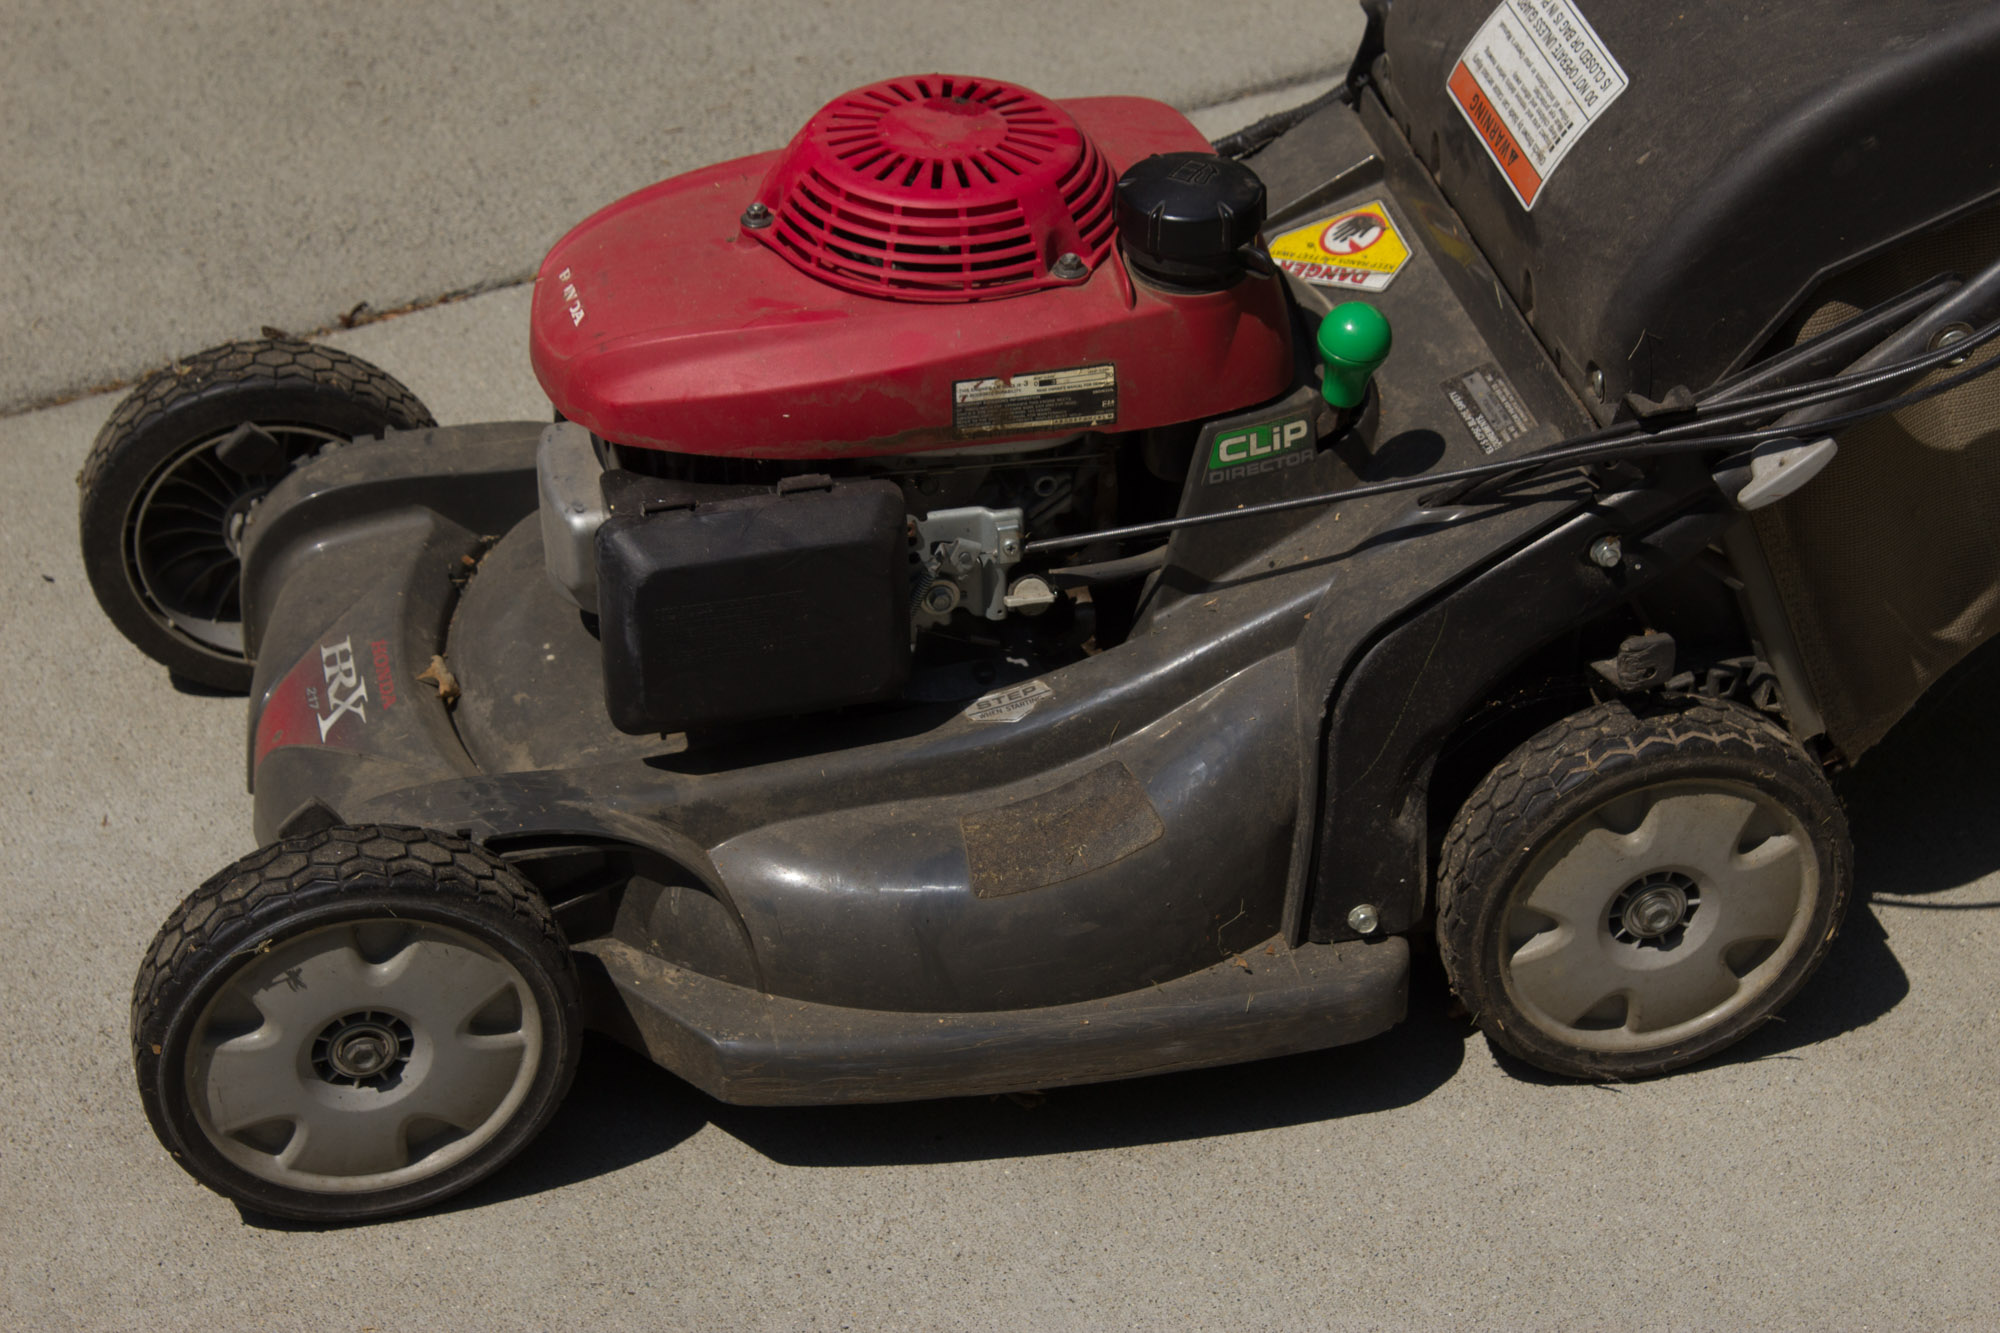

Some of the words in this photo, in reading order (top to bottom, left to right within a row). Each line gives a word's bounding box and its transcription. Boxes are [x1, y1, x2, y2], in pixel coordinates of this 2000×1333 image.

[1547, 3, 1558, 17] IN
[1553, 13, 1564, 26] IS
[1533, 18, 1556, 48] UNLESS
[1560, 21, 1576, 41] BAG
[1571, 38, 1584, 52] OR
[1552, 43, 1578, 78] OPERATE
[1580, 49, 1605, 82] CLOSED
[1529, 68, 1536, 76] in
[1492, 84, 1503, 100] cause
[1573, 75, 1590, 96] NOT
[1601, 78, 1613, 91] IS
[1501, 98, 1510, 109] can
[1528, 98, 1537, 109] and
[1552, 100, 1560, 109] all
[1585, 91, 1598, 107] DO
[1507, 107, 1518, 124] blade
[1524, 109, 1533, 120] and
[1535, 107, 1549, 127] children
[1547, 109, 1556, 119] eye
[1557, 107, 1569, 125] Follow
[1469, 94, 1509, 154] WARNING
[1515, 119, 1524, 130] by
[1548, 124, 1558, 139] Keep
[1448, 391, 1467, 411] SAFETY
[1209, 448, 1314, 484] DIRECTOR
[371, 638, 397, 710] HONDA
[317, 634, 368, 744] HRX
[306, 687, 320, 709] 217
[977, 686, 1036, 710] STEP
[979, 709, 1003, 718] WHEN
